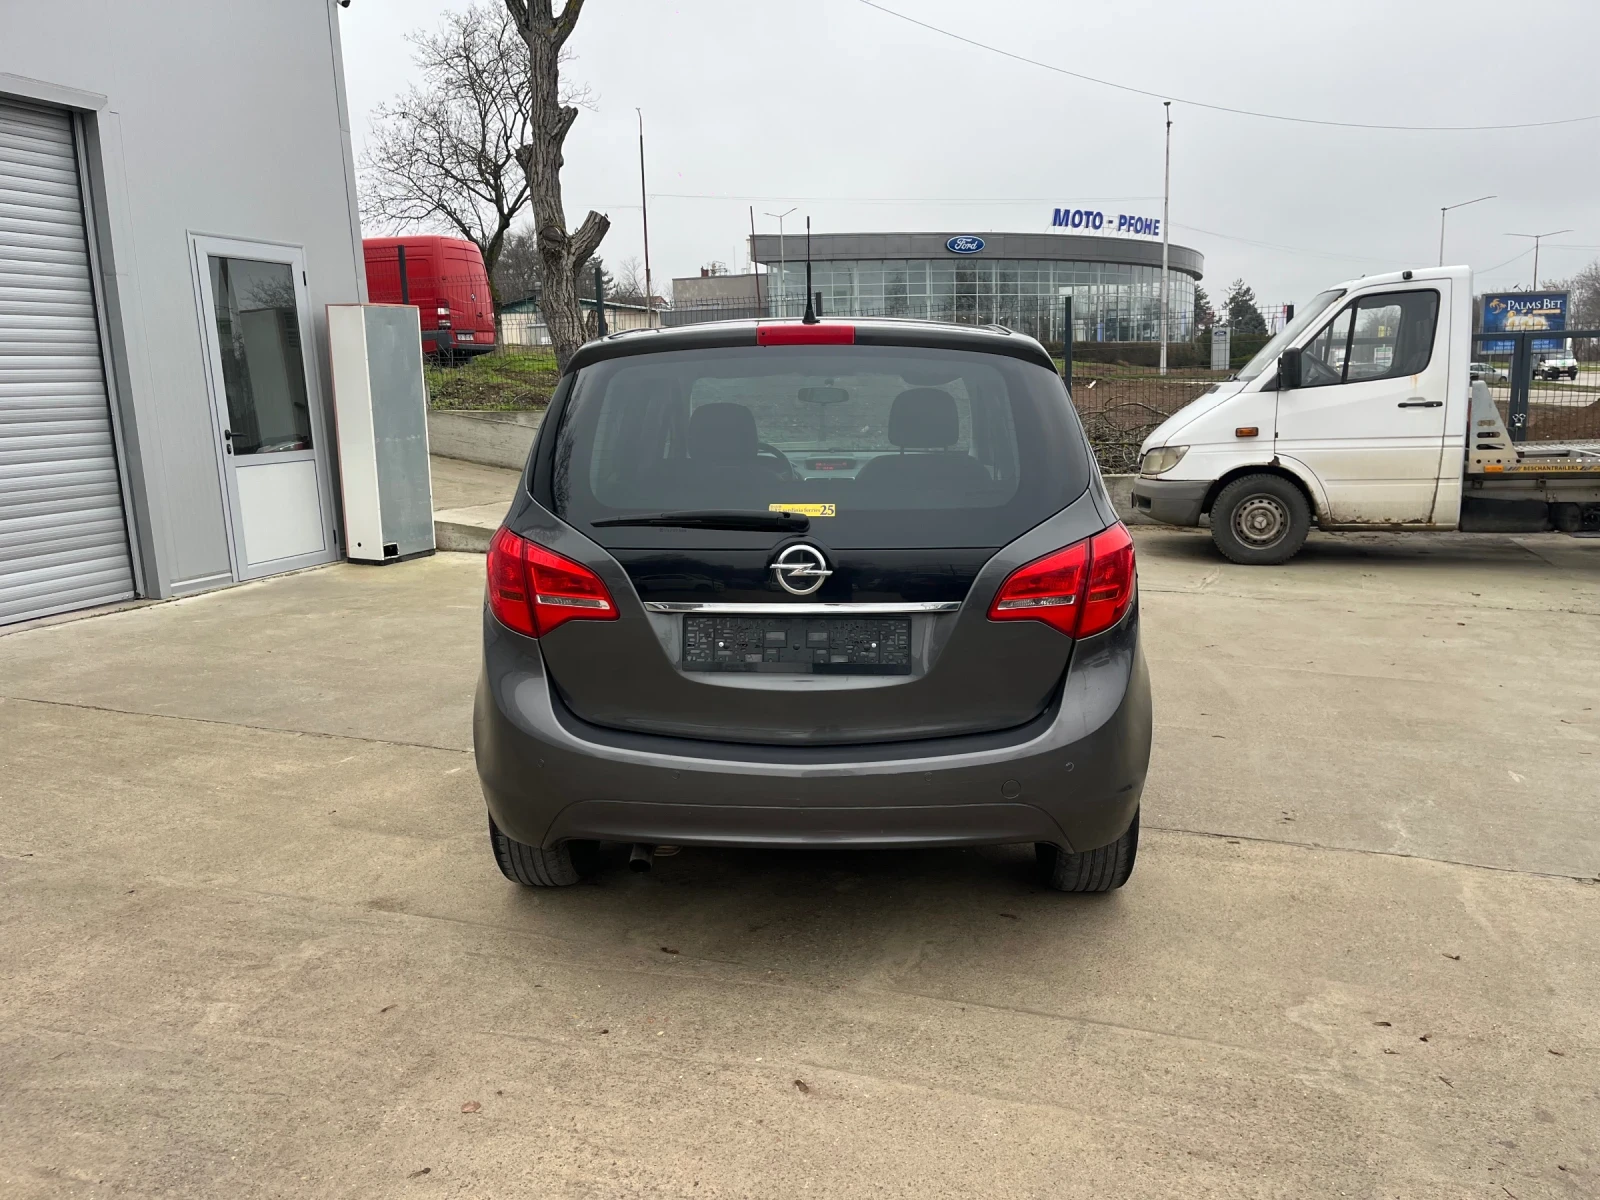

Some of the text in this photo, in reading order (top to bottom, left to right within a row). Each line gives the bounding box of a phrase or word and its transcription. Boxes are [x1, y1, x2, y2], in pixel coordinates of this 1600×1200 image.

[1052, 208, 1104, 230] MOTO
[1117, 214, 1161, 236] PFOHE
[954, 238, 979, 251] Ford
[1507, 298, 1563, 311] PALMS BET
[820, 504, 834, 515] 25
